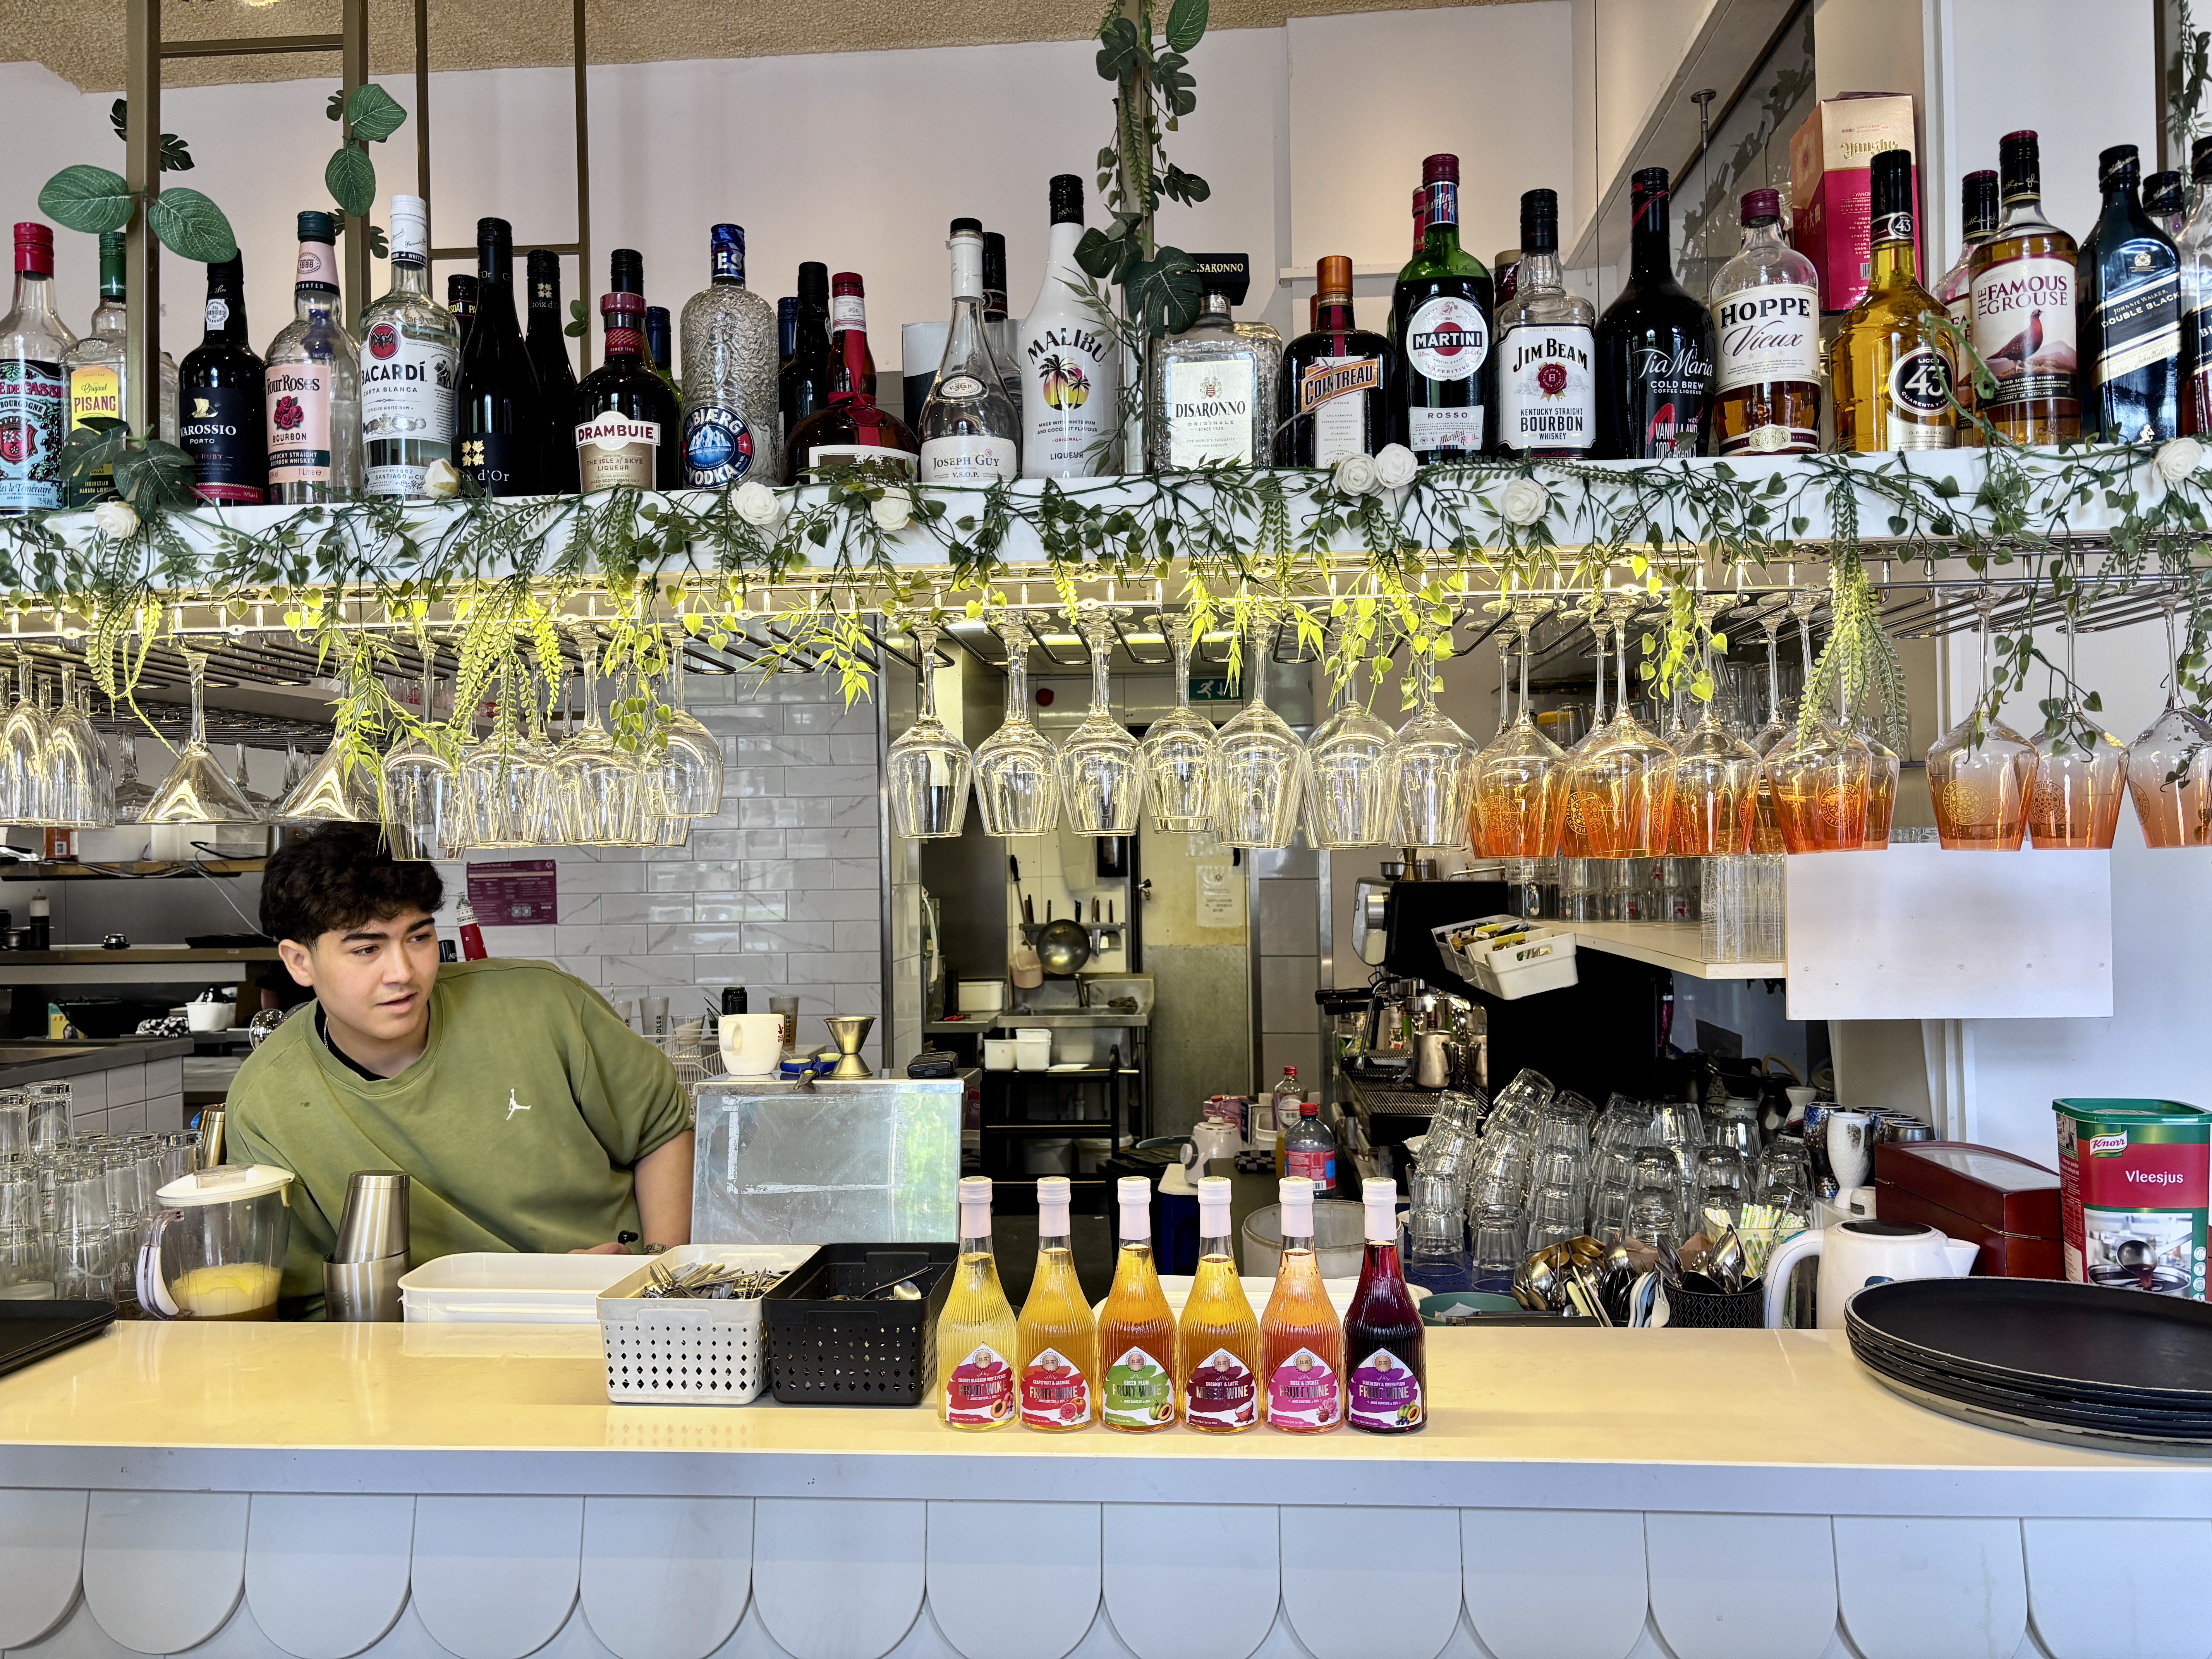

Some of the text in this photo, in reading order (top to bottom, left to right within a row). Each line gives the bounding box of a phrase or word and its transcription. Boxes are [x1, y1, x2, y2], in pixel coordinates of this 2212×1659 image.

[1894, 219, 1911, 232] 43
[1191, 263, 1243, 273] SARONNO
[1987, 275, 2068, 301] FAMOUS
[1978, 287, 1987, 320] THE
[1987, 291, 2068, 314] GROUSE
[2101, 292, 2180, 328] DOUBLE BLACK
[2113, 289, 2169, 315] JOHNNIE WALKER
[1720, 297, 1810, 330] HOPPE
[1027, 328, 1106, 365] MALIBU
[1415, 332, 1480, 348] MARTINI
[1723, 320, 1803, 357] Vieux
[1513, 338, 1588, 373] JIM BEAM
[1632, 348, 1673, 379] Tia
[1663, 348, 1713, 378] Maria
[361, 360, 426, 386] BACARDÍ
[1904, 365, 1946, 397] 43
[81, 383, 108, 394] Original
[267, 374, 320, 395] Four Roses
[363, 388, 380, 397] CARTA
[1305, 365, 1373, 406] COINTREAU
[1650, 380, 1704, 390] COLD BREW
[0, 400, 43, 413] BOURGOGNE
[74, 395, 116, 413] PISANG
[1901, 391, 1934, 408] CUARENTA
[1175, 400, 1246, 418] DISARONNO
[1520, 407, 1583, 416] KENTUCKY STRAIGHT
[180, 424, 237, 438] VAROSSIO
[1521, 416, 1583, 433] BOURBON
[273, 433, 307, 443] BOURBON
[578, 424, 654, 442] DRAMBUIE
[1539, 432, 1566, 440] WHISKEY
[270, 452, 288, 461] KENTUCKY
[270, 458, 288, 467] BOURBON
[933, 455, 1000, 471] JOSEPH GUY
[1050, 452, 1084, 460] LIQUEUR
[477, 469, 510, 481] d'Or
[689, 464, 740, 486] VODKA
[15, 483, 52, 494] Téméraire
[2092, 1137, 2126, 1149] Knorr
[2125, 1170, 2184, 1187] Vleesjus
[958, 1381, 1007, 1397] FRUIT WINE
[1029, 1385, 1078, 1400] FRUIT WINE
[1112, 1384, 1161, 1397] FRUIT WINE
[1226, 1384, 1249, 1399] WINE
[1279, 1384, 1329, 1398] FRUIT WINE
[1359, 1384, 1410, 1400] FRUIT WINE
